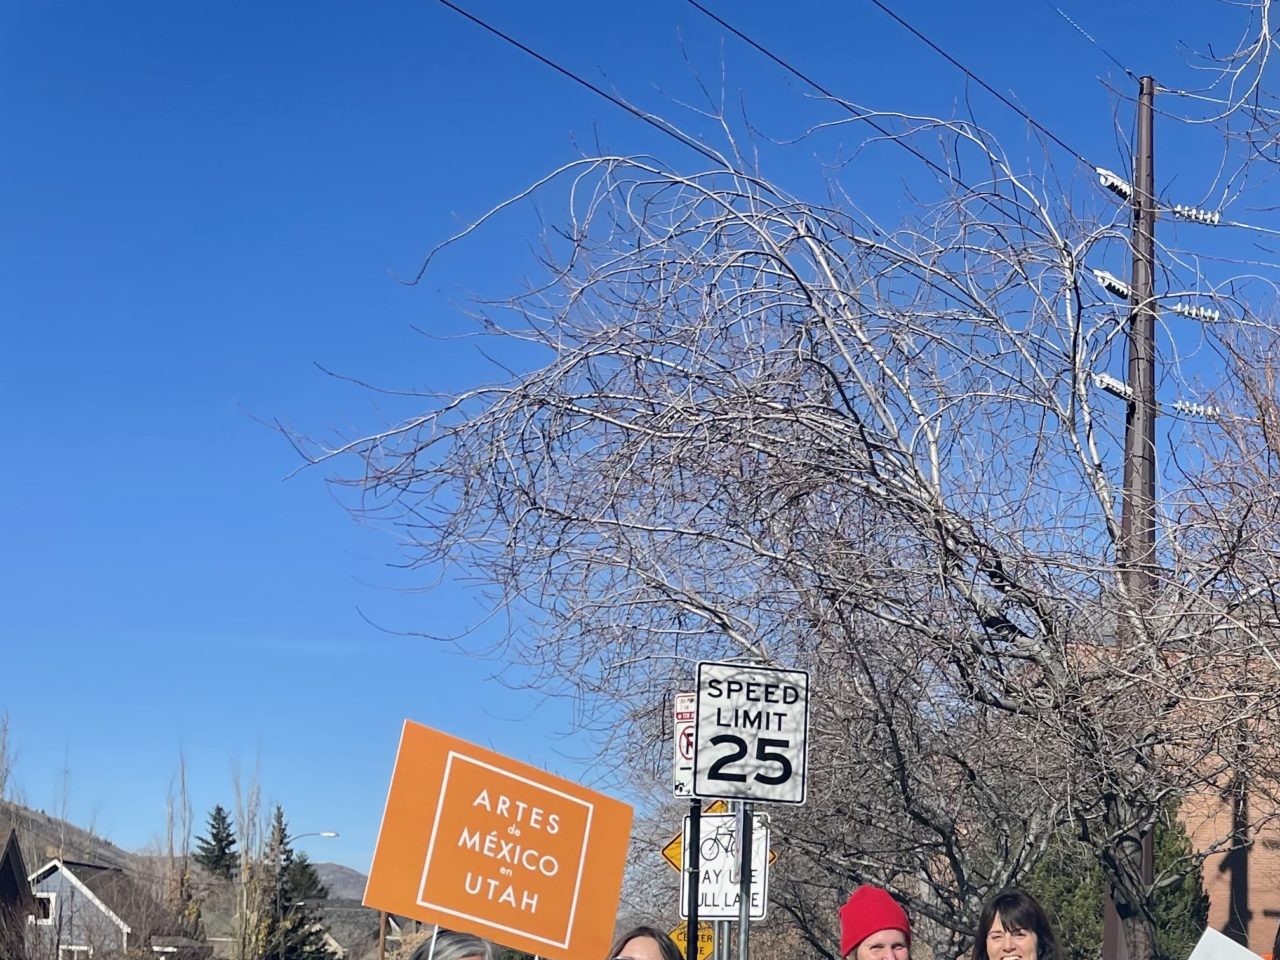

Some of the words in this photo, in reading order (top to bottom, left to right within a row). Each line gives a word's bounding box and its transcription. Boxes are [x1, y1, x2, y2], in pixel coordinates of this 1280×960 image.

[707, 679, 799, 704] SPEED
[716, 708, 787, 731] LIMIT
[707, 735, 793, 786] 25
[472, 789, 560, 835] ARTES
[507, 823, 521, 837] de
[458, 826, 559, 877] MÉXICO
[500, 866, 513, 877] en
[729, 869, 758, 885] UE
[464, 872, 539, 913] UTAH
[698, 892, 719, 907] ULL
[725, 892, 759, 907] LAE
[677, 931, 713, 943] CEER
